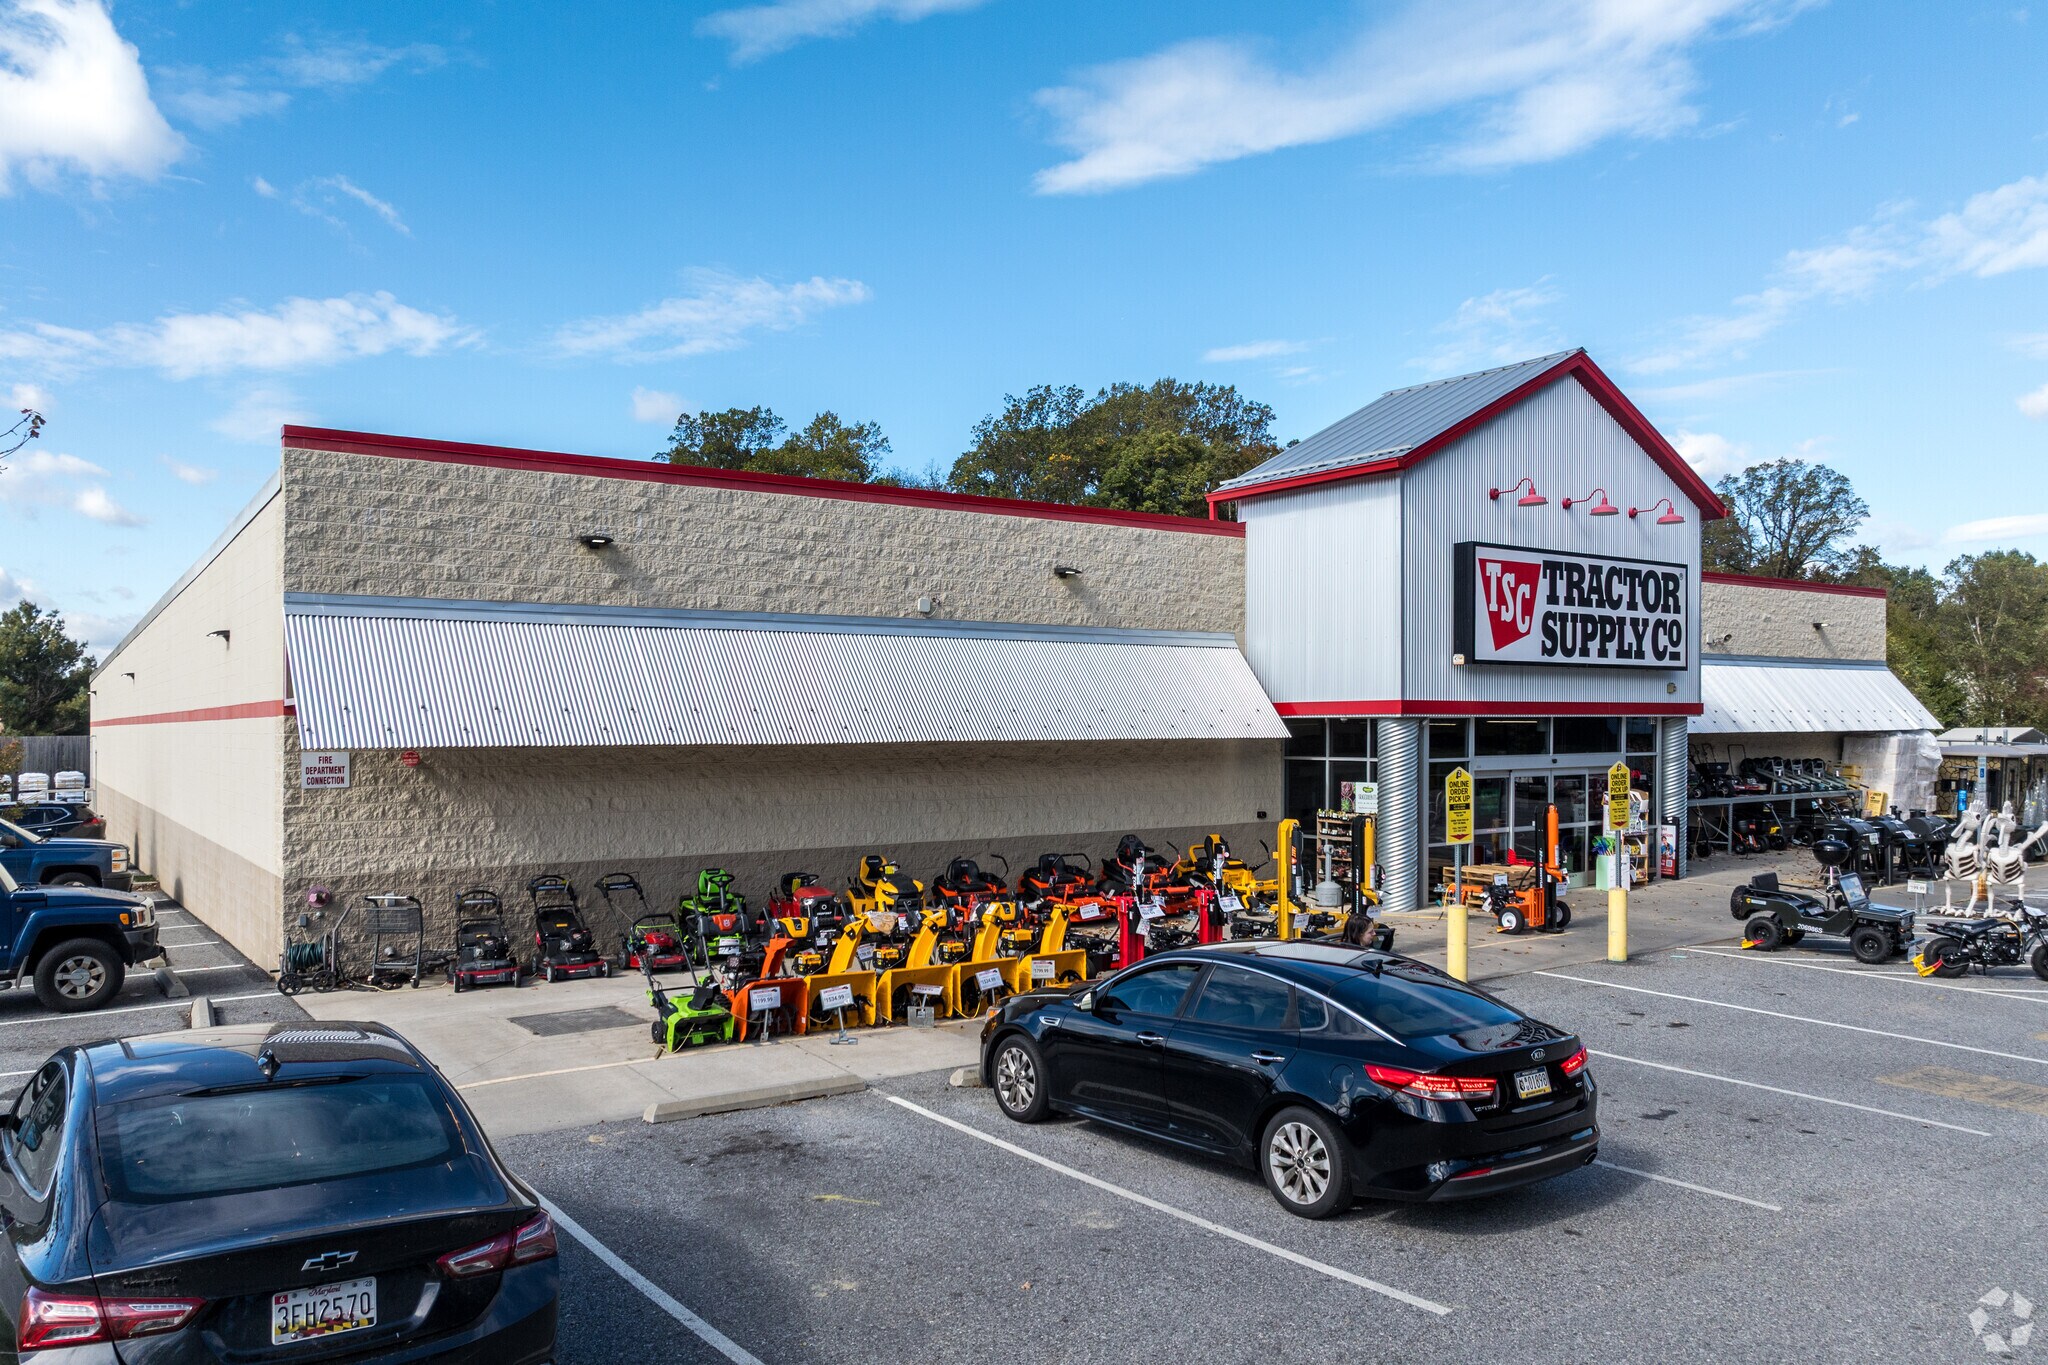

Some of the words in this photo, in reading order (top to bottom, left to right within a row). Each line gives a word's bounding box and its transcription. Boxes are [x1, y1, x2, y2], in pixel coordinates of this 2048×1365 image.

[1542, 560, 1681, 614] TRACTOR
[1486, 562, 1530, 633] TSC
[1541, 610, 1649, 660] SUPPLY
[318, 756, 333, 764] FIRE
[306, 766, 345, 775] DEPARTMENT
[307, 776, 345, 785] CONNECTION
[1449, 795, 1461, 803] PICK
[308, 1284, 342, 1297] Maryland
